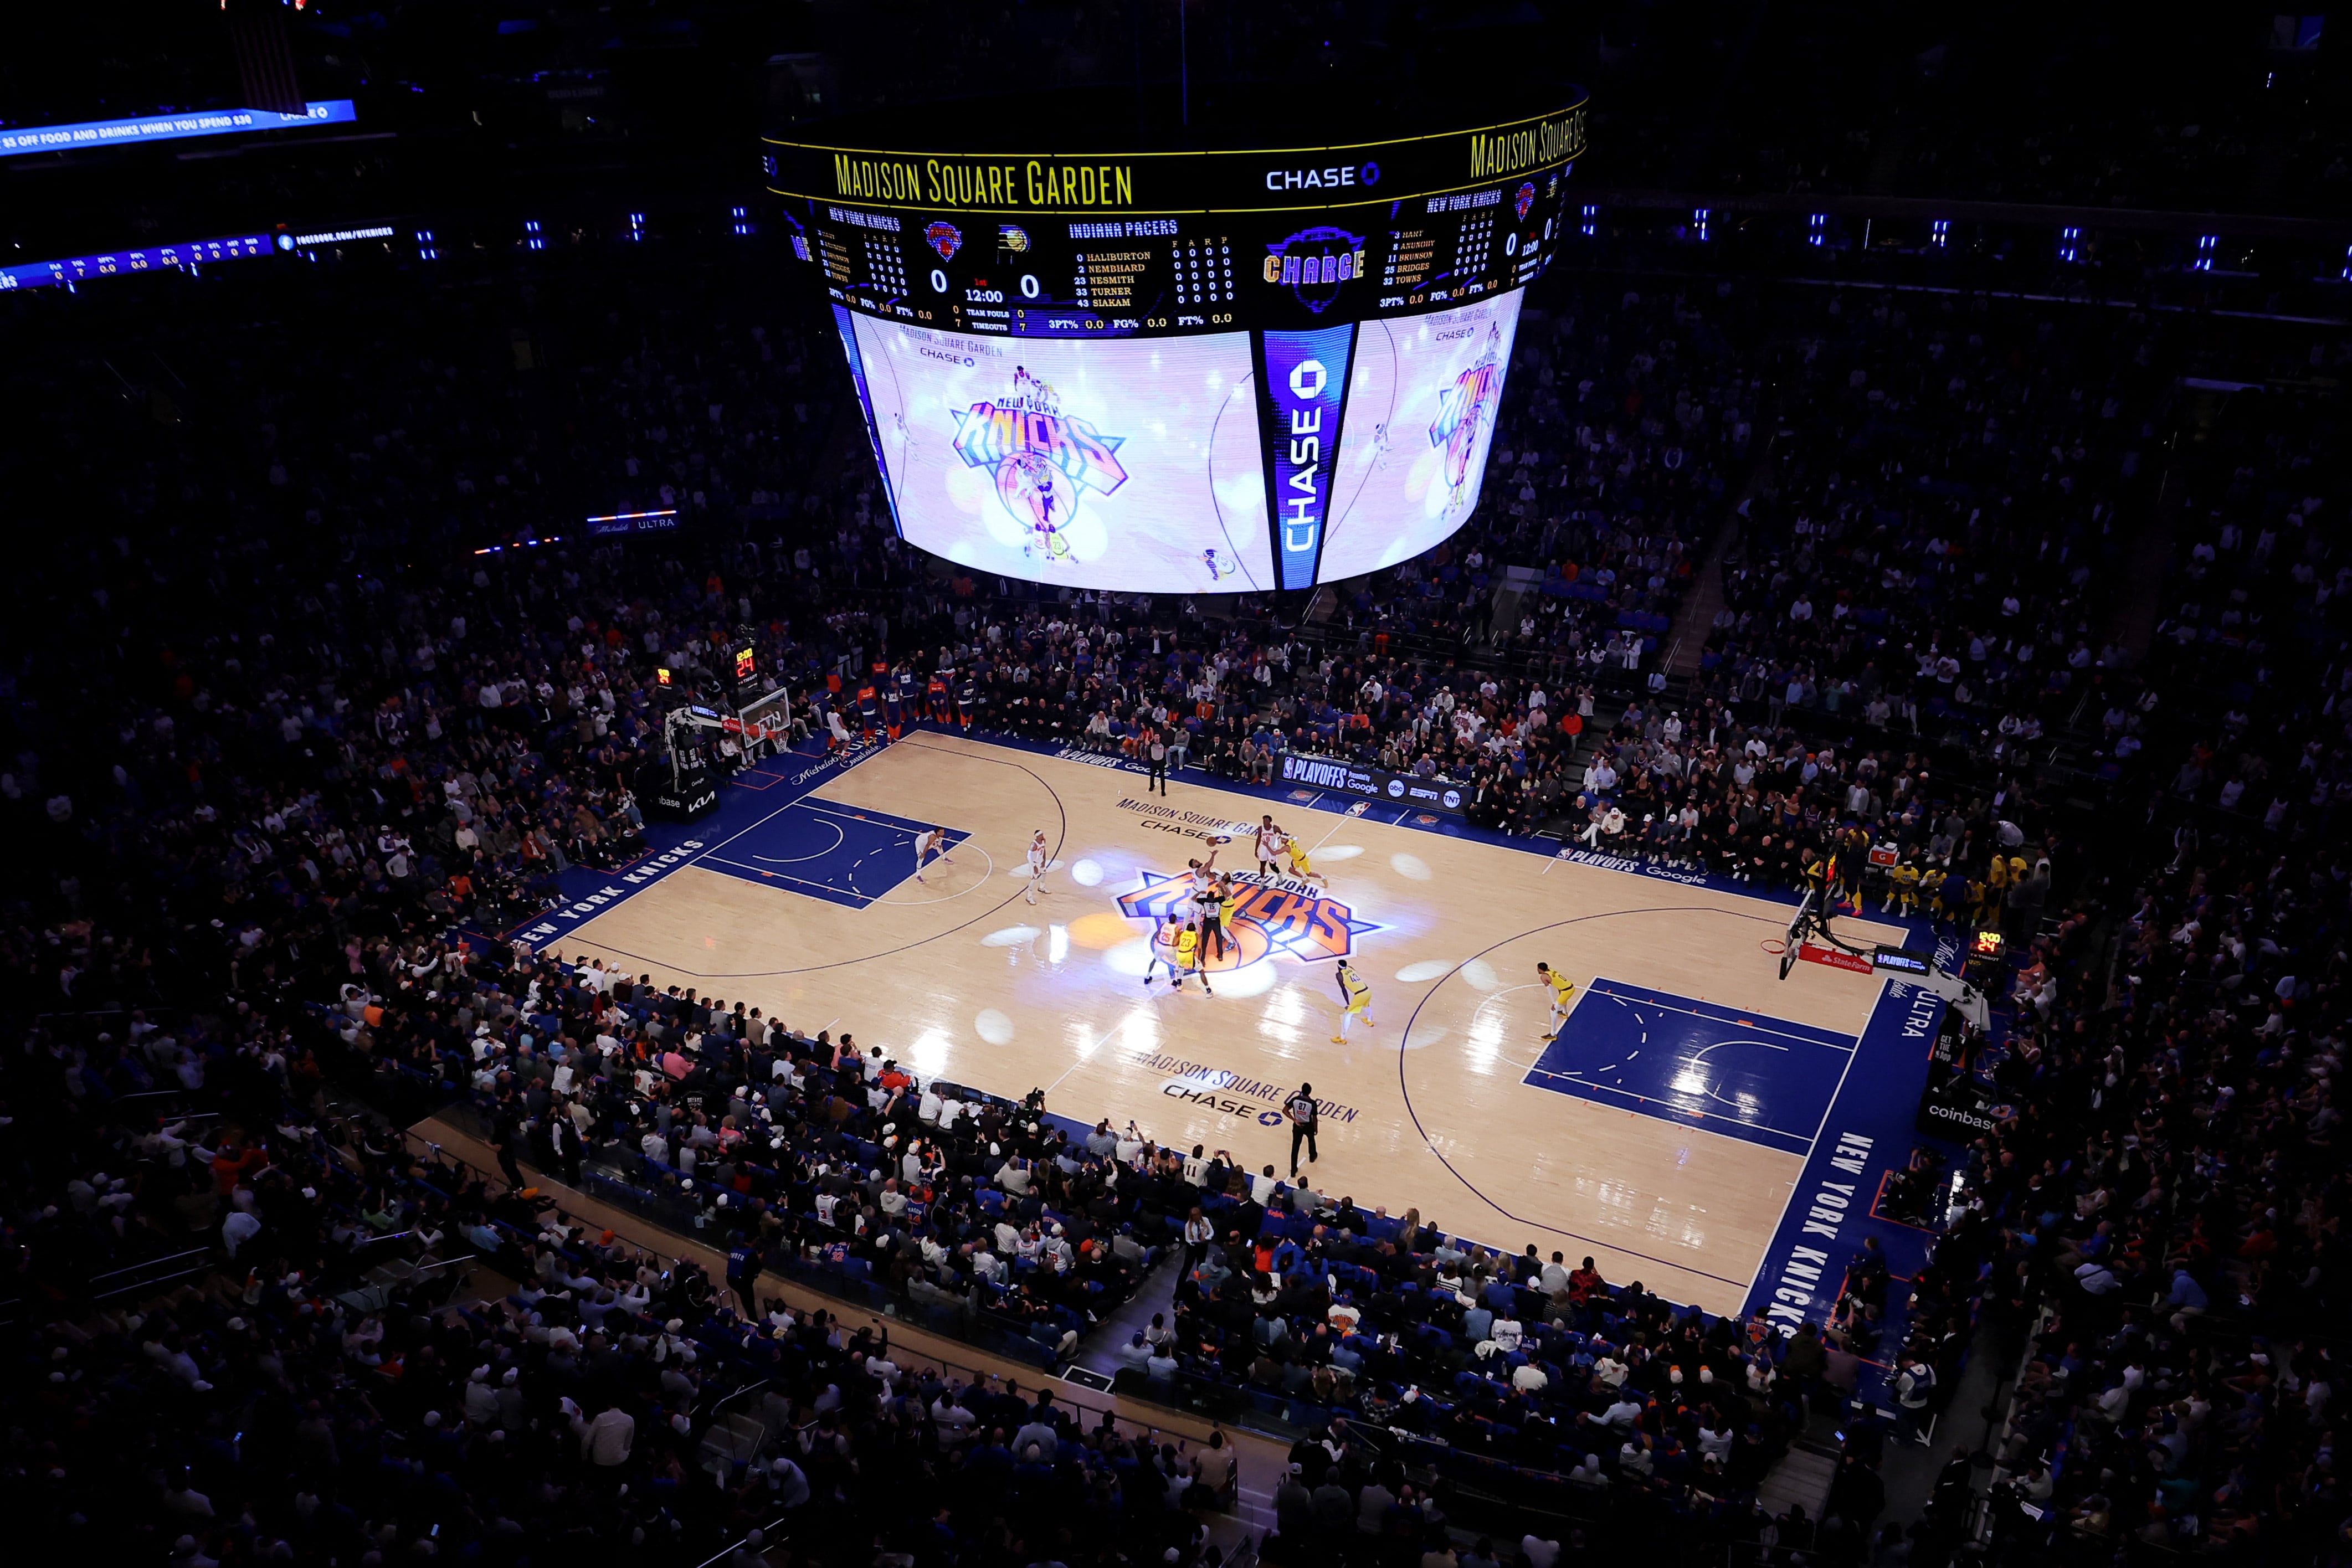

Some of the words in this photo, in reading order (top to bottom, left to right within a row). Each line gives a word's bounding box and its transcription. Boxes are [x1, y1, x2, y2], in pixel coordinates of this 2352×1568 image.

[2, 137, 17, 149] $5
[17, 134, 39, 146] OFF
[39, 131, 72, 145] FOOD
[73, 128, 98, 141] AND
[98, 125, 139, 138] DRINKS
[139, 121, 174, 135] WHEN
[174, 119, 198, 131] YOU
[198, 115, 233, 129] SPEND
[233, 114, 253, 126] $30
[1471, 128, 1537, 178] MADISON
[1539, 117, 1574, 162] SQUARE
[834, 153, 921, 202] MADISON
[927, 158, 1018, 207] SQUARE
[1026, 160, 1132, 205] GARDEN
[1266, 166, 1355, 191] CHASE
[1426, 197, 1447, 213] NEW
[1449, 193, 1472, 212] YORK
[1472, 189, 1502, 208] KNICKS
[844, 209, 867, 227] YORK
[866, 213, 901, 232] KNICKS
[1069, 222, 1123, 239] INDIANA
[1125, 219, 1179, 238] PACERS
[1544, 218, 1552, 240] 0
[1172, 240, 1178, 248] F
[1188, 239, 1195, 247] A
[1221, 236, 1228, 244] P
[1506, 233, 1516, 256] 0
[1522, 239, 1539, 256] 12:00
[1076, 253, 1084, 262] 0
[1086, 251, 1152, 262] HALIBURTON
[1387, 254, 1398, 263] 11
[1398, 250, 1434, 262] BRUNSON
[1077, 265, 1085, 274] 2
[1087, 263, 1146, 274] NEMBHARD
[1263, 250, 1365, 284] CHARGE
[1385, 265, 1395, 275] 25
[1396, 262, 1430, 274] BRIDGES
[931, 269, 947, 293] 0
[974, 277, 988, 286] 1st
[1020, 274, 1040, 299] 0
[1074, 276, 1086, 285] 23
[1089, 275, 1136, 285] NESMITH
[1383, 276, 1393, 286] 32
[1395, 274, 1422, 285] TOWNS
[965, 288, 1004, 304] 12:00
[1076, 287, 1088, 296] 33
[1091, 286, 1133, 296] TURNER
[1379, 296, 1404, 308] 3PT%
[1409, 293, 1424, 305] 0.0
[1430, 290, 1448, 302] FG%
[1452, 286, 1465, 298] 0.0
[1468, 283, 1483, 295] FT%
[1487, 279, 1498, 290] 0.0
[845, 292, 856, 304] 0.0
[879, 302, 892, 313] 0.0
[917, 309, 932, 320] 0.0
[1077, 299, 1090, 307] 43
[1092, 298, 1131, 307] SIAKAM
[953, 305, 960, 314] 0
[966, 308, 986, 317] TEAM
[987, 309, 1010, 318] FOULS
[1016, 309, 1025, 318] 0
[955, 318, 961, 328] 7
[971, 322, 1008, 331] TIMEOUTS
[1019, 322, 1026, 332] 7
[1048, 319, 1079, 330] 3PT%
[1085, 319, 1104, 330] 0.0
[1112, 318, 1139, 329] FG%
[1147, 317, 1167, 328] 0.0
[1178, 315, 1204, 326] FT%
[1212, 313, 1233, 324] 0.0
[1435, 328, 1467, 341] CHASE
[920, 347, 962, 364] CHASE
[997, 397, 1023, 409] NEW
[1026, 398, 1062, 418] YORK
[952, 400, 1129, 497] KNICKS
[1285, 406, 1322, 552] CHASE
[638, 518, 675, 529] ULTRA
[736, 647, 753, 662] 12:00
[736, 657, 754, 678] 24
[1067, 750, 1123, 768] PLAYOFFS
[790, 756, 839, 785] Michelob
[1292, 759, 1347, 789] PLAYOFFS
[1347, 779, 1379, 794] Google
[1389, 784, 1403, 793] abc
[1409, 786, 1439, 801] ESPN
[1115, 798, 1180, 819] MADISON
[1178, 811, 1235, 831] SQUARE
[1140, 820, 1211, 841] CHASE
[1569, 850, 1640, 873] PLAYOFFS
[1645, 866, 1707, 885] Google
[557, 885, 625, 921] YORK
[622, 839, 705, 885] KNICKS
[1276, 878, 1319, 899] YORK
[1161, 931, 1172, 942] 25
[1180, 938, 1192, 948] 23
[1979, 931, 2001, 944] 12:00
[1978, 939, 1995, 952] 24
[1832, 957, 1852, 968] State
[1851, 960, 1871, 972] Farm
[1883, 954, 1910, 968] PLAYOFFS
[1349, 973, 1361, 983] 43
[1558, 974, 1567, 982] 0
[1901, 989, 1938, 1037] ULTRA
[1939, 1042, 1951, 1052] THE
[1940, 1034, 1953, 1043] GET
[1136, 1050, 1214, 1082] MADISON
[1213, 1070, 1286, 1102] SQUARE
[1163, 1083, 1258, 1119] CHASE
[1929, 1105, 1996, 1130] coinbas
[1830, 1132, 1874, 1175] NEW
[1187, 1164, 1196, 1178] 11
[819, 1209, 827, 1219] 3
[1801, 1180, 1856, 1241] YORK
[907, 1214, 922, 1226] 14
[1766, 1244, 1829, 1340] KNICKS
